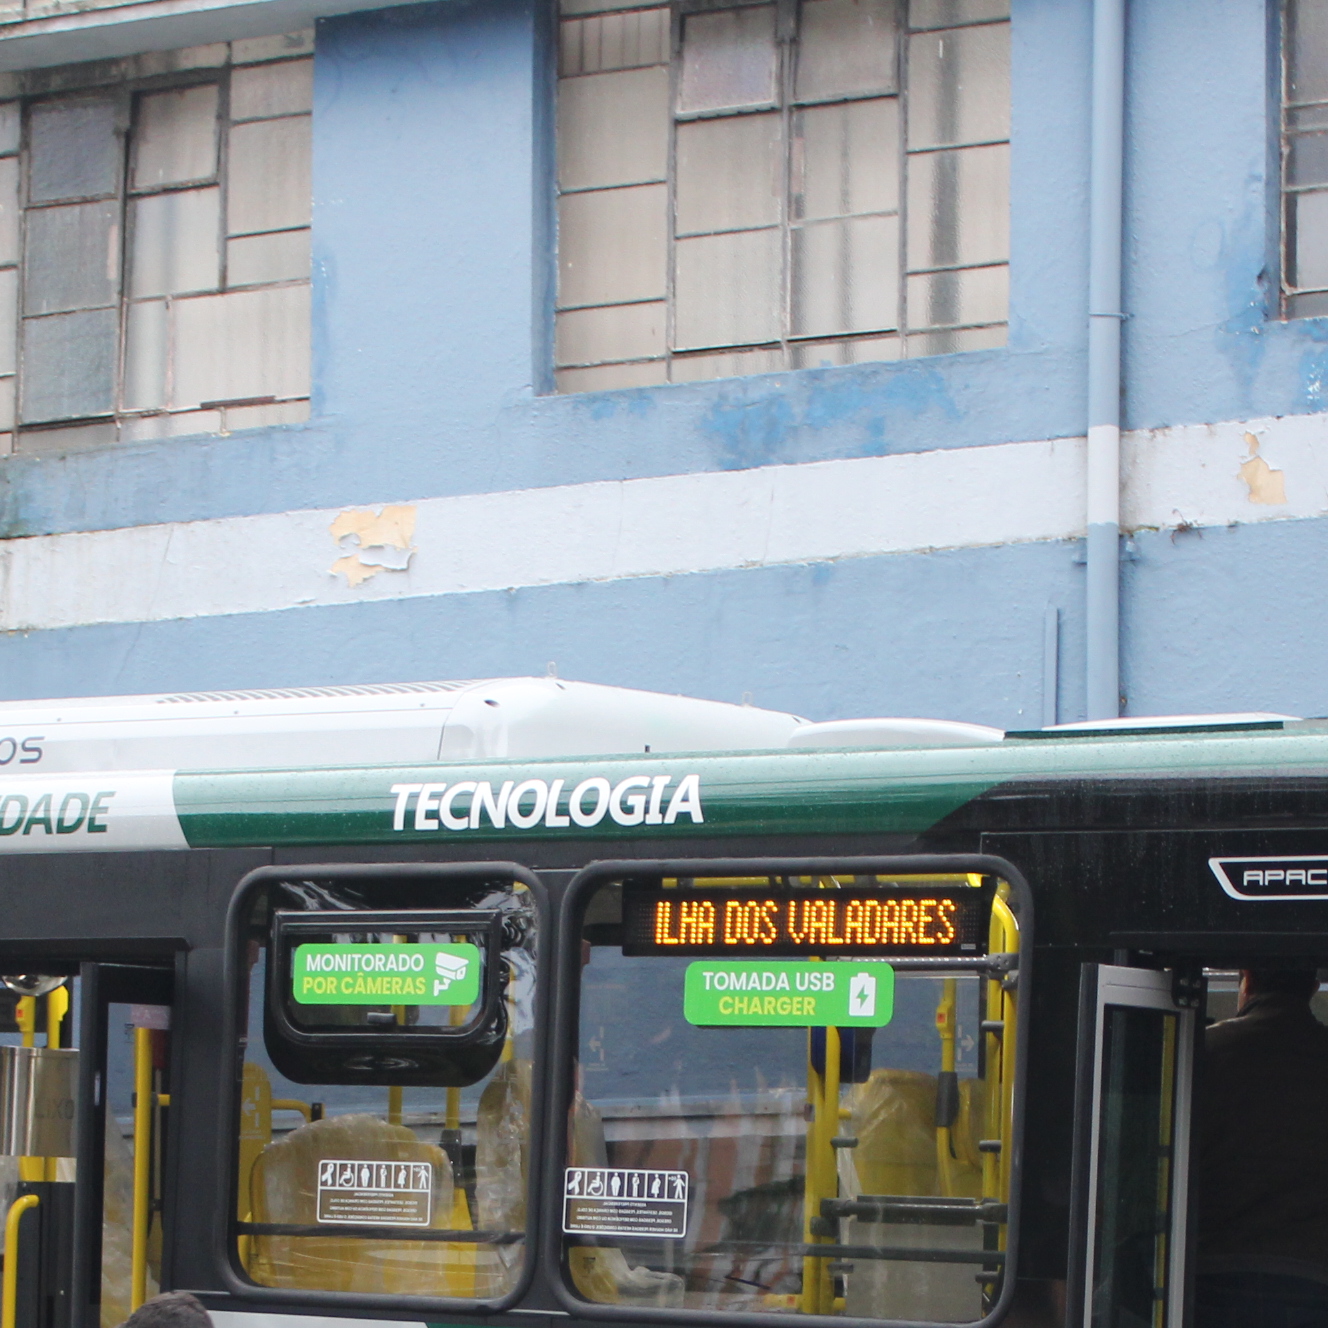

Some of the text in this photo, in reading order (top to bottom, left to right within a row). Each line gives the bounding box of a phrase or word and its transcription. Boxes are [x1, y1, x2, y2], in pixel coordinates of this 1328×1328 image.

[390, 774, 704, 832] TECNOLOGIA
[655, 899, 957, 946] ILHA DOS VALADARES
[305, 953, 425, 974] MONITORADO
[302, 972, 427, 997] POR CÂMERAS
[702, 971, 835, 993] TOMADA USB
[718, 995, 816, 1016] CHARGER
